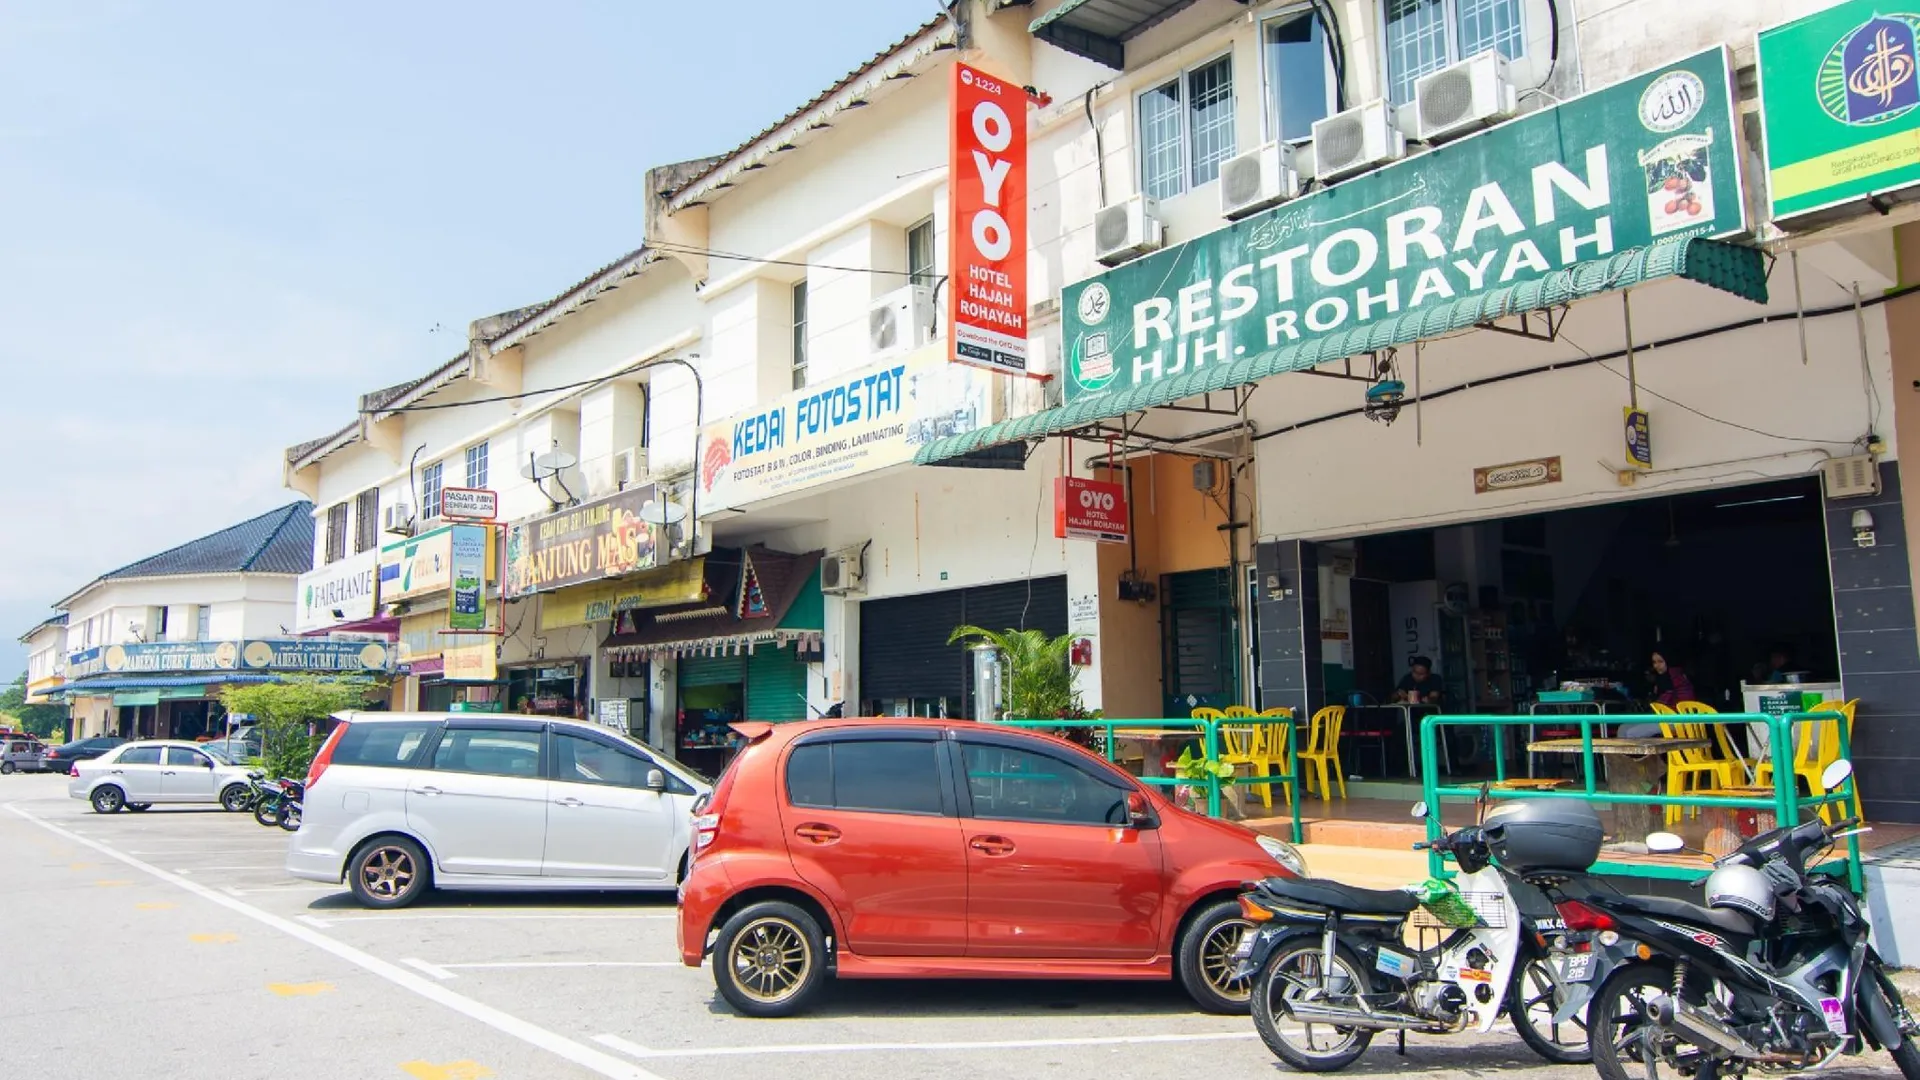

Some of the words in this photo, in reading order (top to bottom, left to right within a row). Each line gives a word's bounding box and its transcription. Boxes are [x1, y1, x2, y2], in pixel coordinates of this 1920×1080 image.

[974, 76, 1003, 96] 1224
[971, 100, 1013, 263] OYO
[1132, 142, 1611, 350] RESTORAN
[969, 263, 1013, 289] HOTEL
[969, 283, 1013, 308] HAJAH
[1131, 330, 1246, 384] HJH.
[1265, 215, 1614, 347] ROHAYAH
[960, 299, 1022, 329] ROHAYAH
[732, 405, 786, 463] KEDAI
[795, 365, 906, 444] FOTOSTAT
[733, 464, 765, 482] FOTOSTAT
[851, 423, 904, 447] LAMINATING
[445, 492, 474, 502] PASAR
[1080, 490, 1115, 511] OYO
[1068, 516, 1093, 527] HAJAH
[1093, 519, 1125, 531] ROHAYAH
[1086, 510, 1109, 520] HOTEL
[519, 538, 592, 590] TANJUNG
[596, 526, 639, 571] MAS
